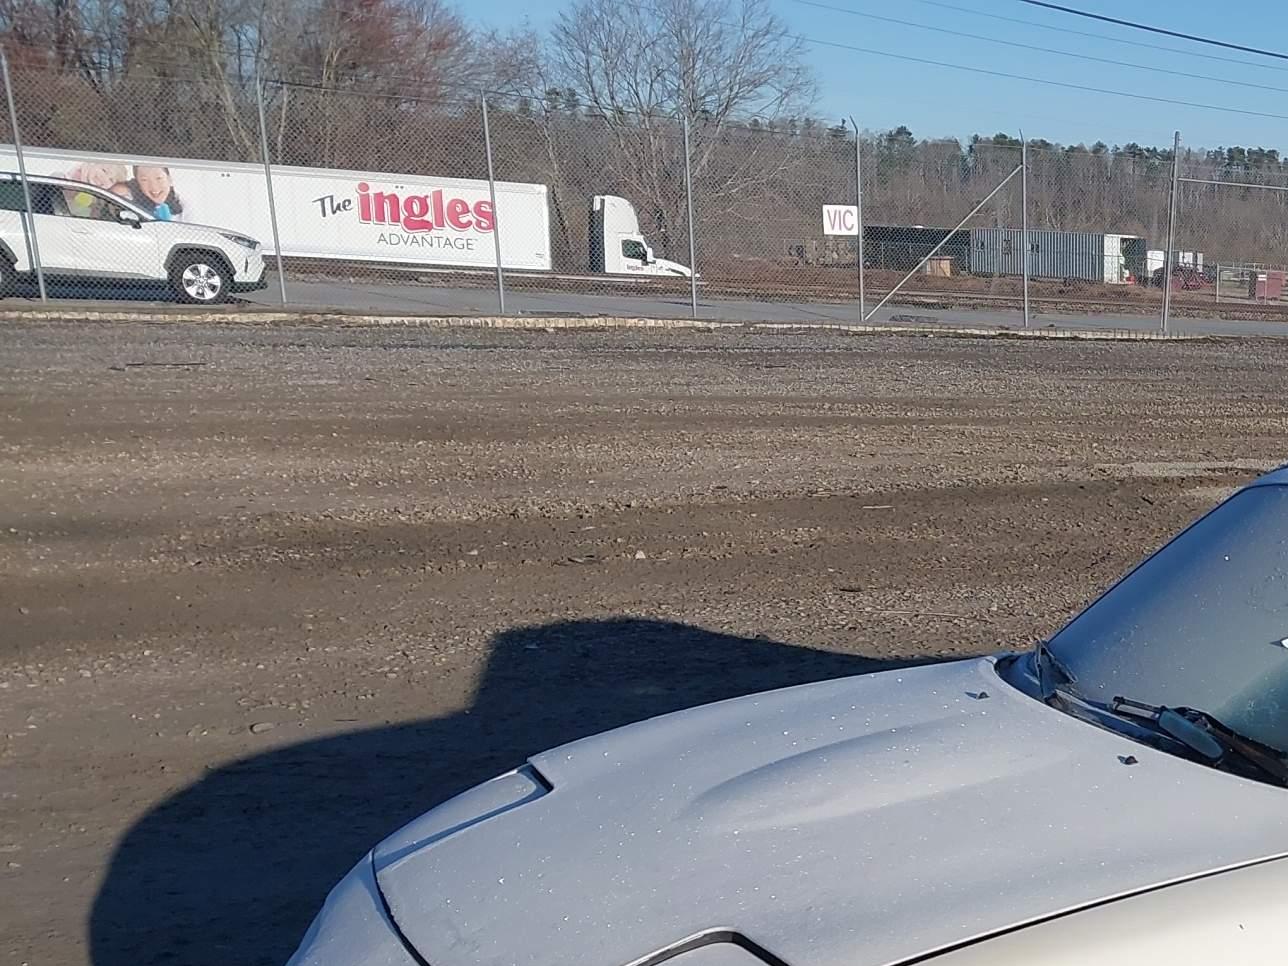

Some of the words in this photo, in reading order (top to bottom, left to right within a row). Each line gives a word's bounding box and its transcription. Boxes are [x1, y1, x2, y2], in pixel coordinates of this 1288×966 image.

[312, 194, 353, 218] The
[356, 182, 495, 233] ingles
[826, 209, 855, 231] VIC
[377, 232, 475, 250] ADVANTAGE
